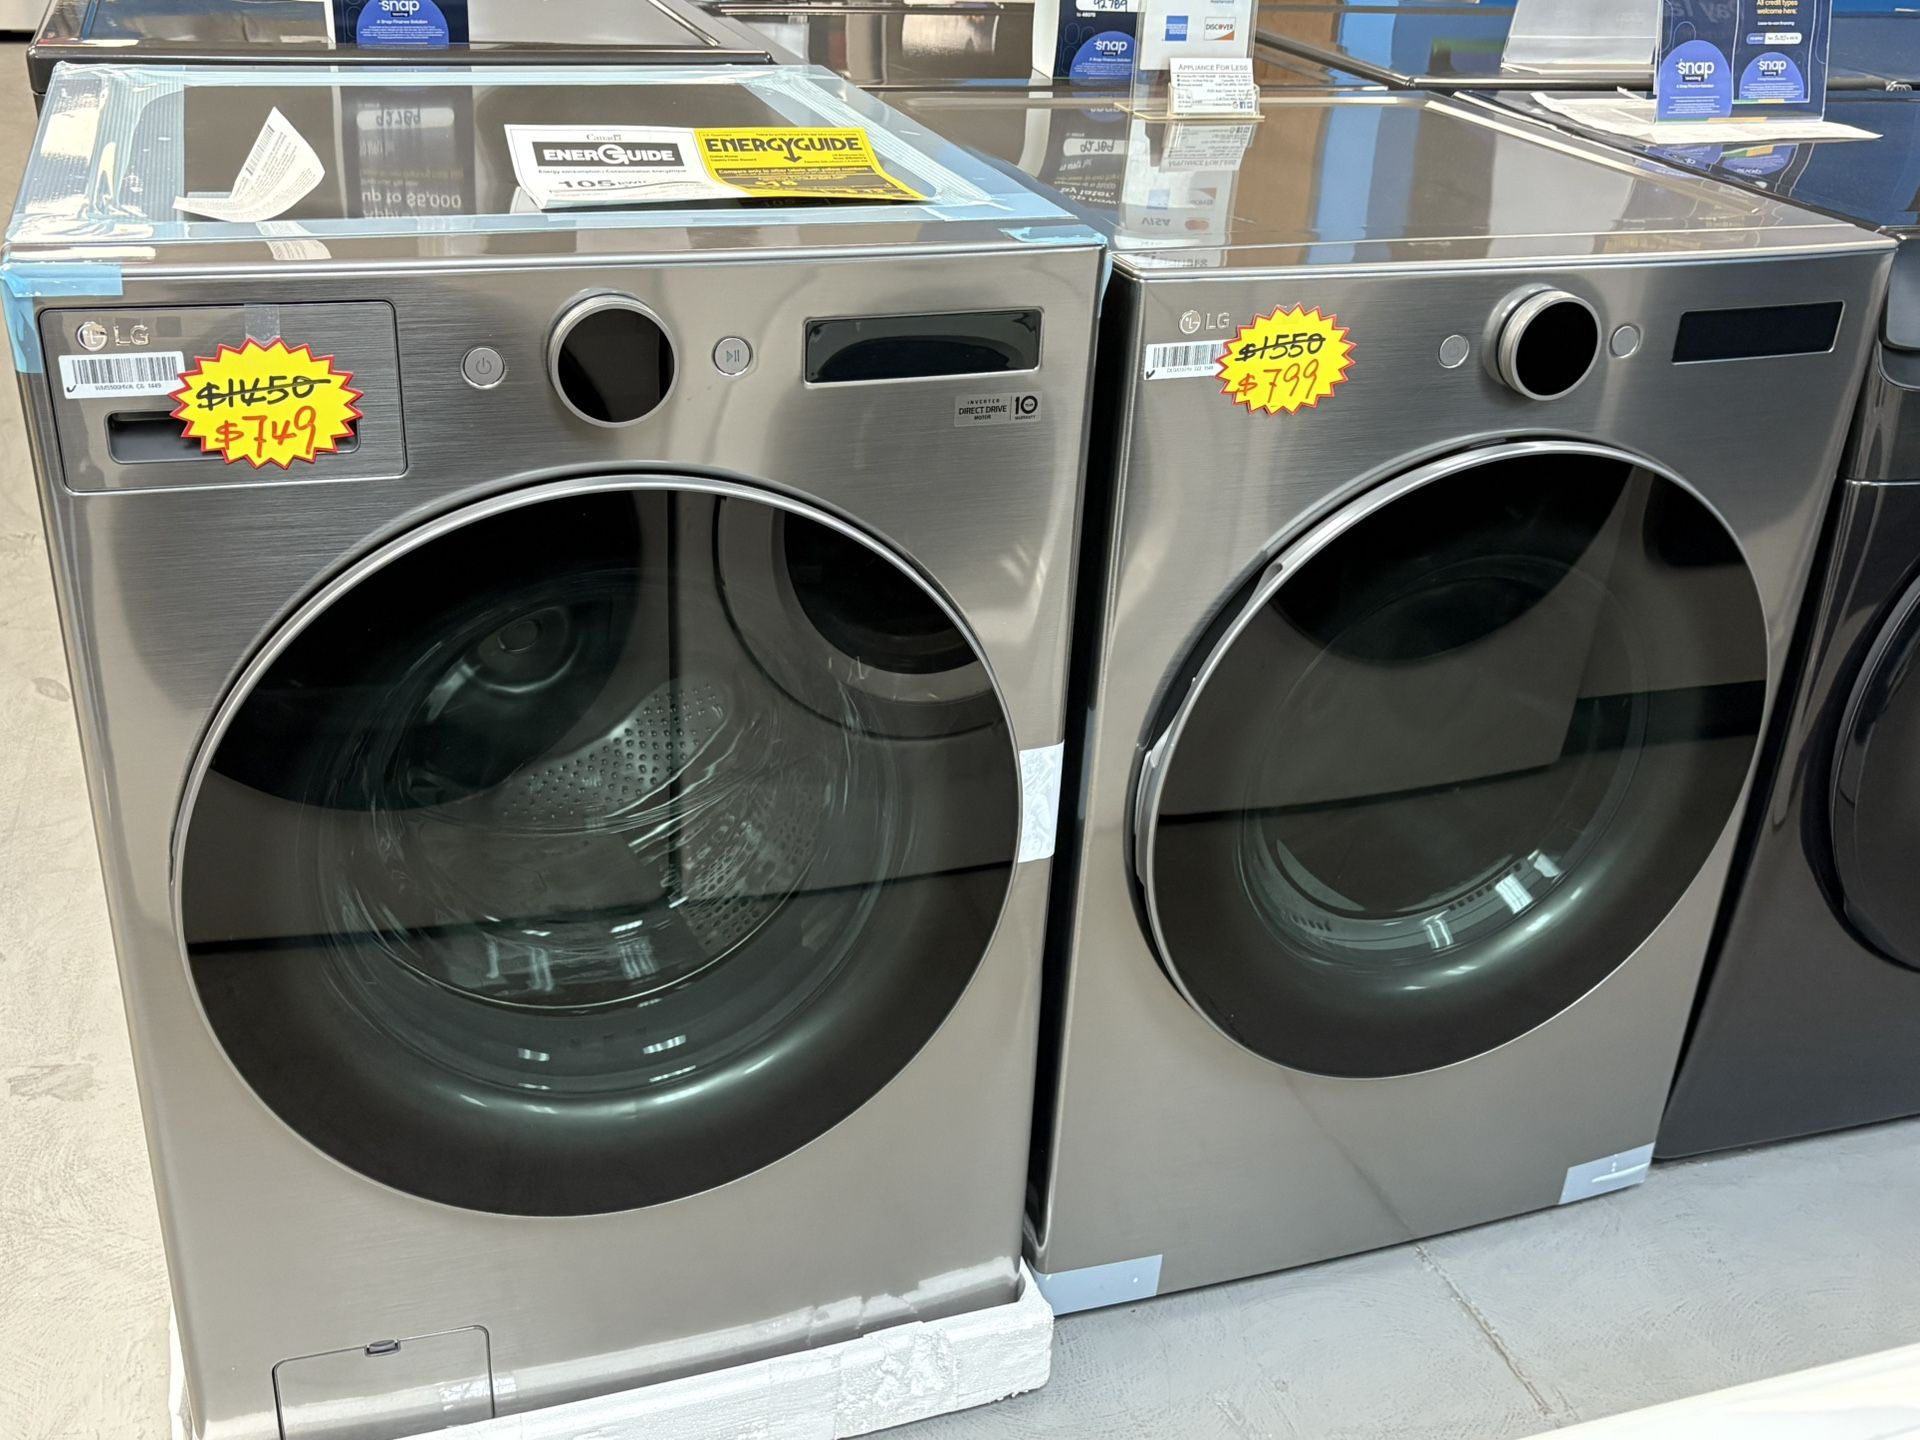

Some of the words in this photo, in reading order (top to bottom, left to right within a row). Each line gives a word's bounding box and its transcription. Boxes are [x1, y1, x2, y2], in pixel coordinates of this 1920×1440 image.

[381, 0, 420, 15] snap
[1205, 23, 1234, 31] DISCOVER
[1095, 40, 1128, 55] snap
[1677, 61, 1715, 78] snap
[1758, 59, 1787, 74] snap
[704, 137, 863, 154] ENERGYGUIDE
[543, 144, 675, 165] ENERGUIDE
[558, 180, 616, 188] 105
[1205, 312, 1230, 331] LG
[113, 324, 149, 345] LG
[1235, 332, 1322, 361] $1550
[1236, 358, 1319, 403] $799
[958, 406, 984, 415] DIRECT
[985, 405, 1007, 414] DRIVE
[1014, 395, 1038, 415] 10
[214, 405, 318, 456] $749
